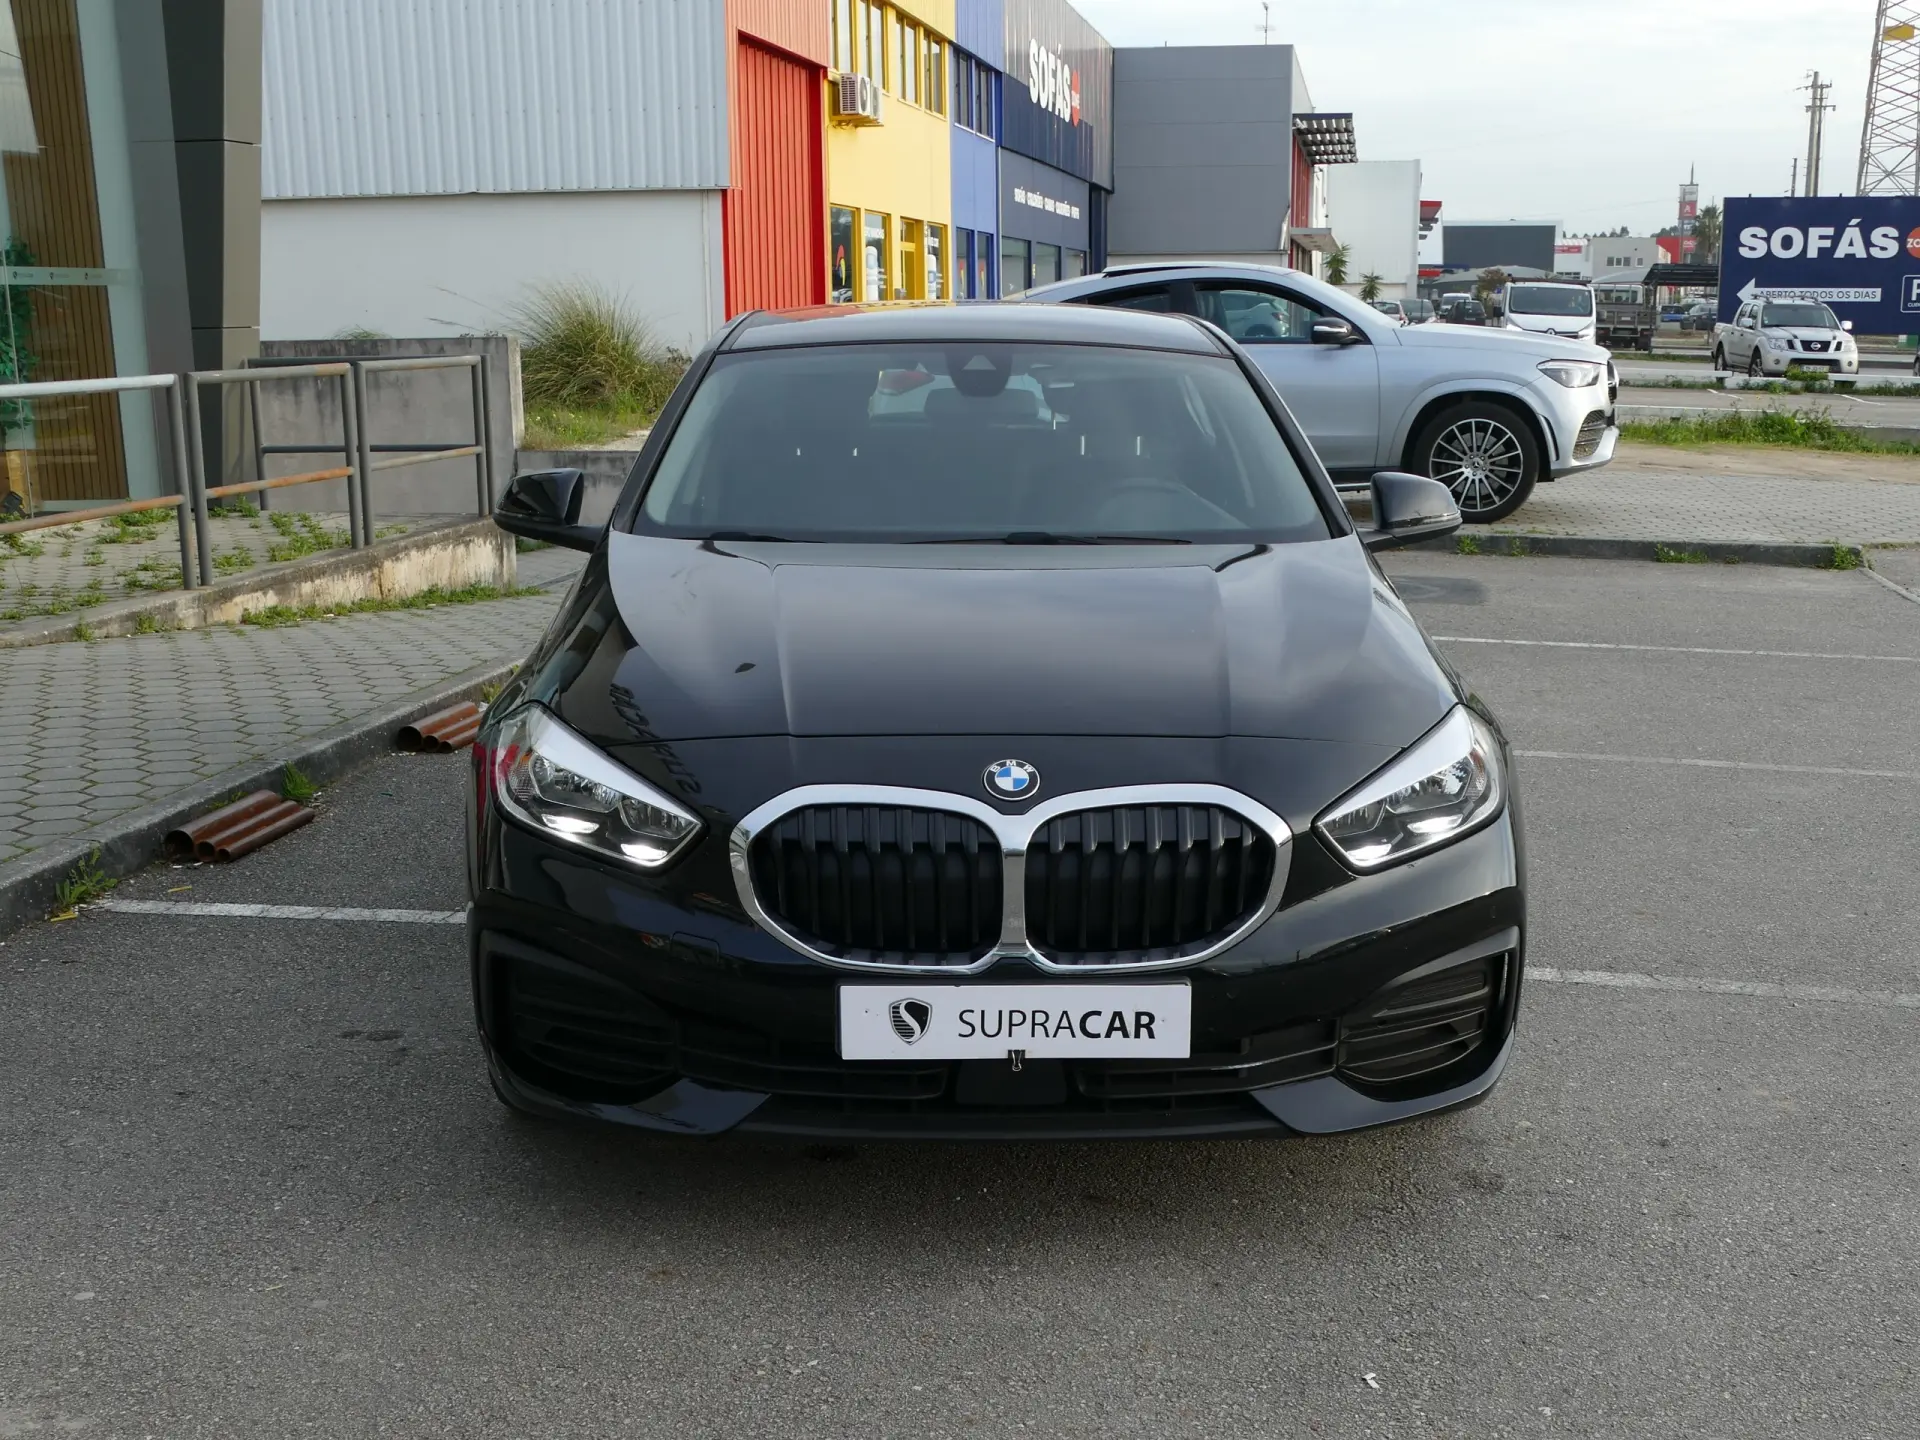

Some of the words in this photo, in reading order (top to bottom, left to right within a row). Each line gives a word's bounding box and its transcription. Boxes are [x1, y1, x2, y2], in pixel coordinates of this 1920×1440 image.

[1029, 38, 1071, 123] SOFÁS
[1738, 218, 1900, 259] SOFÁS
[1759, 290, 1796, 299] ABERTO
[1799, 290, 1834, 299] TODOS
[1837, 290, 1851, 299] OS
[1854, 290, 1877, 299] DIAS
[990, 760, 1035, 773] BMW
[958, 1009, 1156, 1039] SUPRACAR
